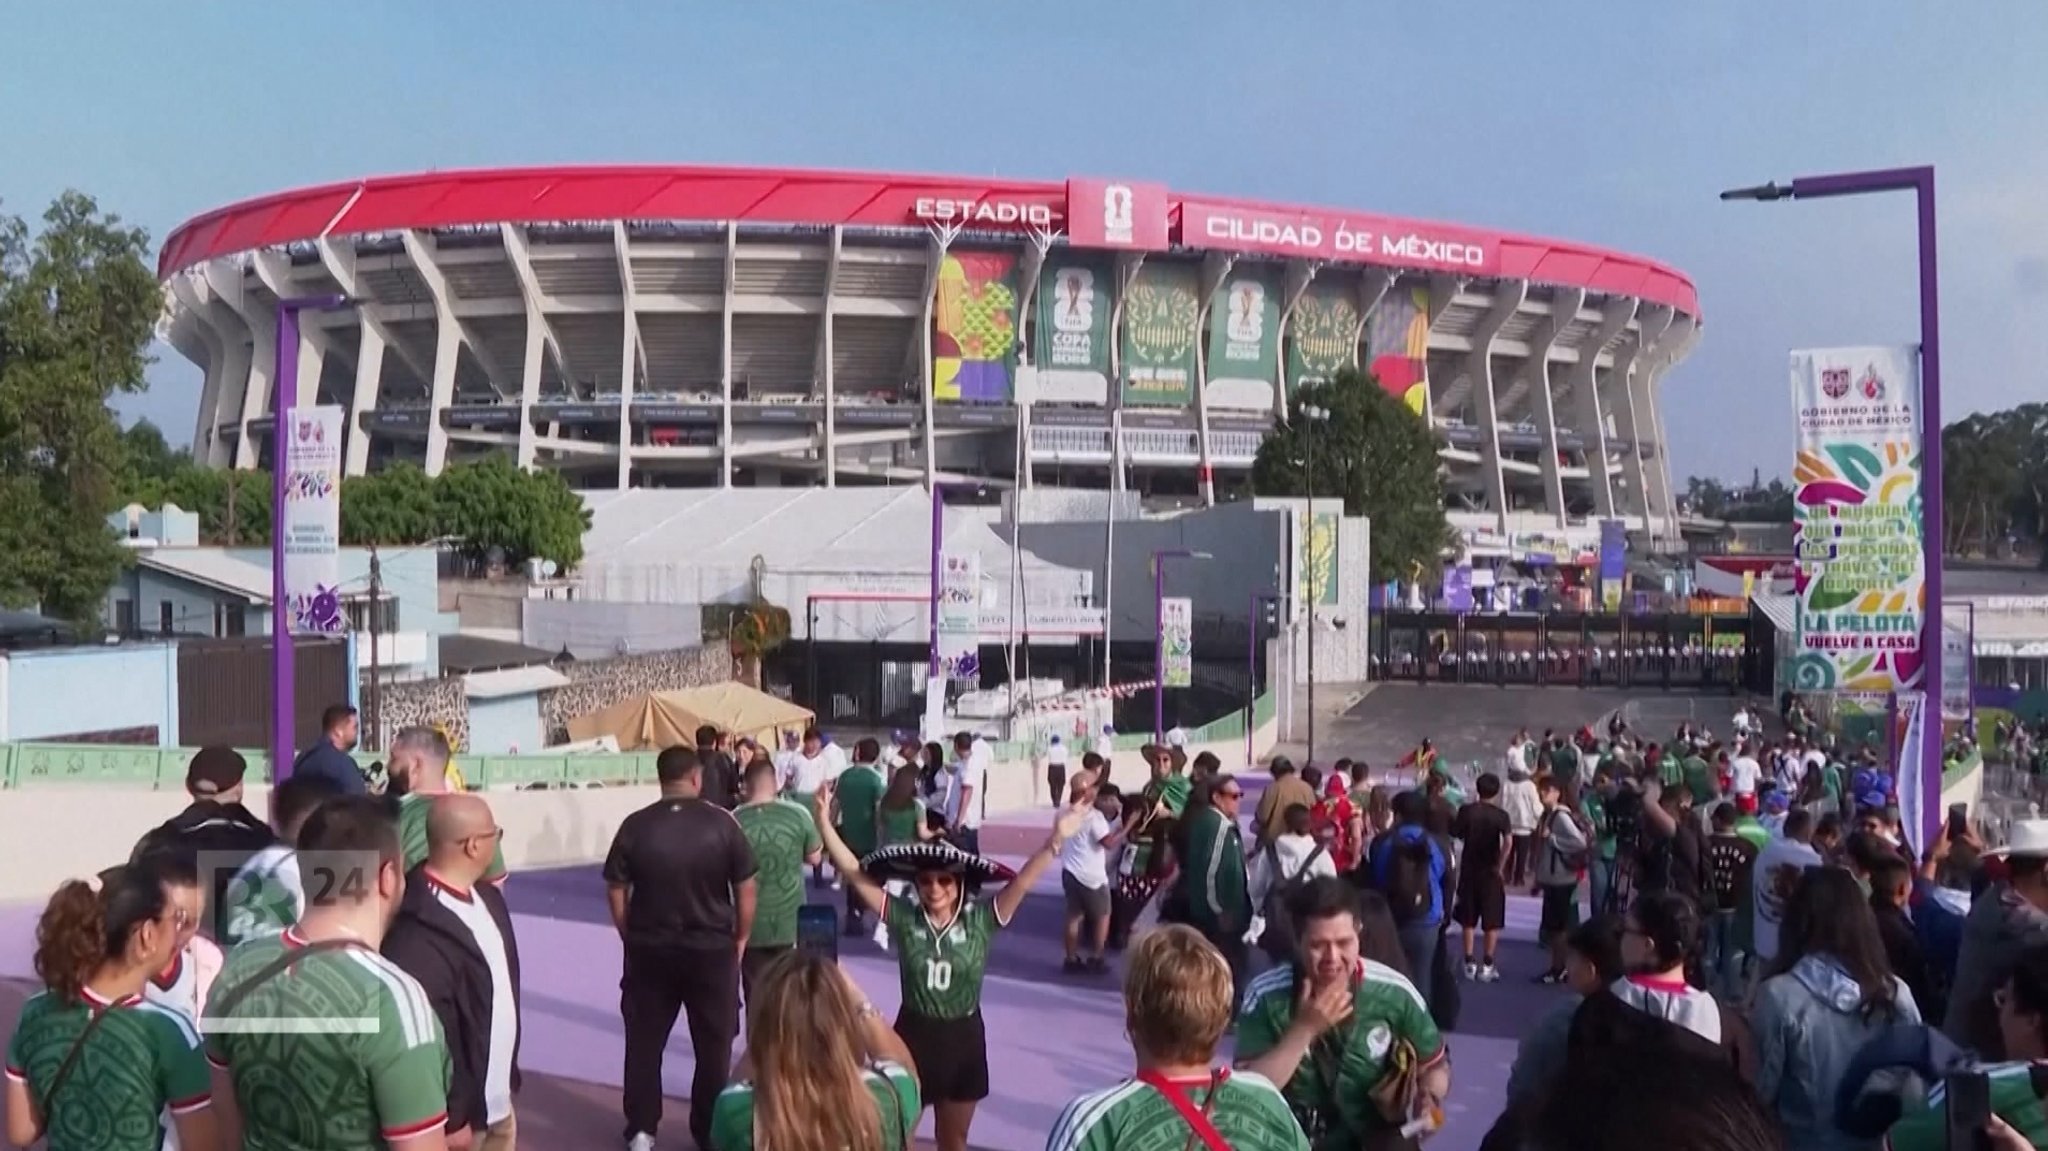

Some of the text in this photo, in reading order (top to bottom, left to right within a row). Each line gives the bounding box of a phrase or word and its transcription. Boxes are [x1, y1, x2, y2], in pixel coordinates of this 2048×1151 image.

[916, 197, 1050, 224] ESTADIO
[1206, 217, 1483, 266] CIUDAD DE MÉXICO
[1052, 334, 1091, 346] COPA
[1801, 405, 1868, 417] GOBIERNO
[1801, 417, 1845, 429] CIUDAD
[1848, 417, 1863, 426] DE
[1839, 505, 1908, 519] MUNDIAL
[1838, 543, 1918, 556] PERSONAS
[1804, 614, 1915, 631] LA PELOTA
[1805, 636, 1915, 648] VUELVE A CASA
[926, 957, 952, 992] 10
